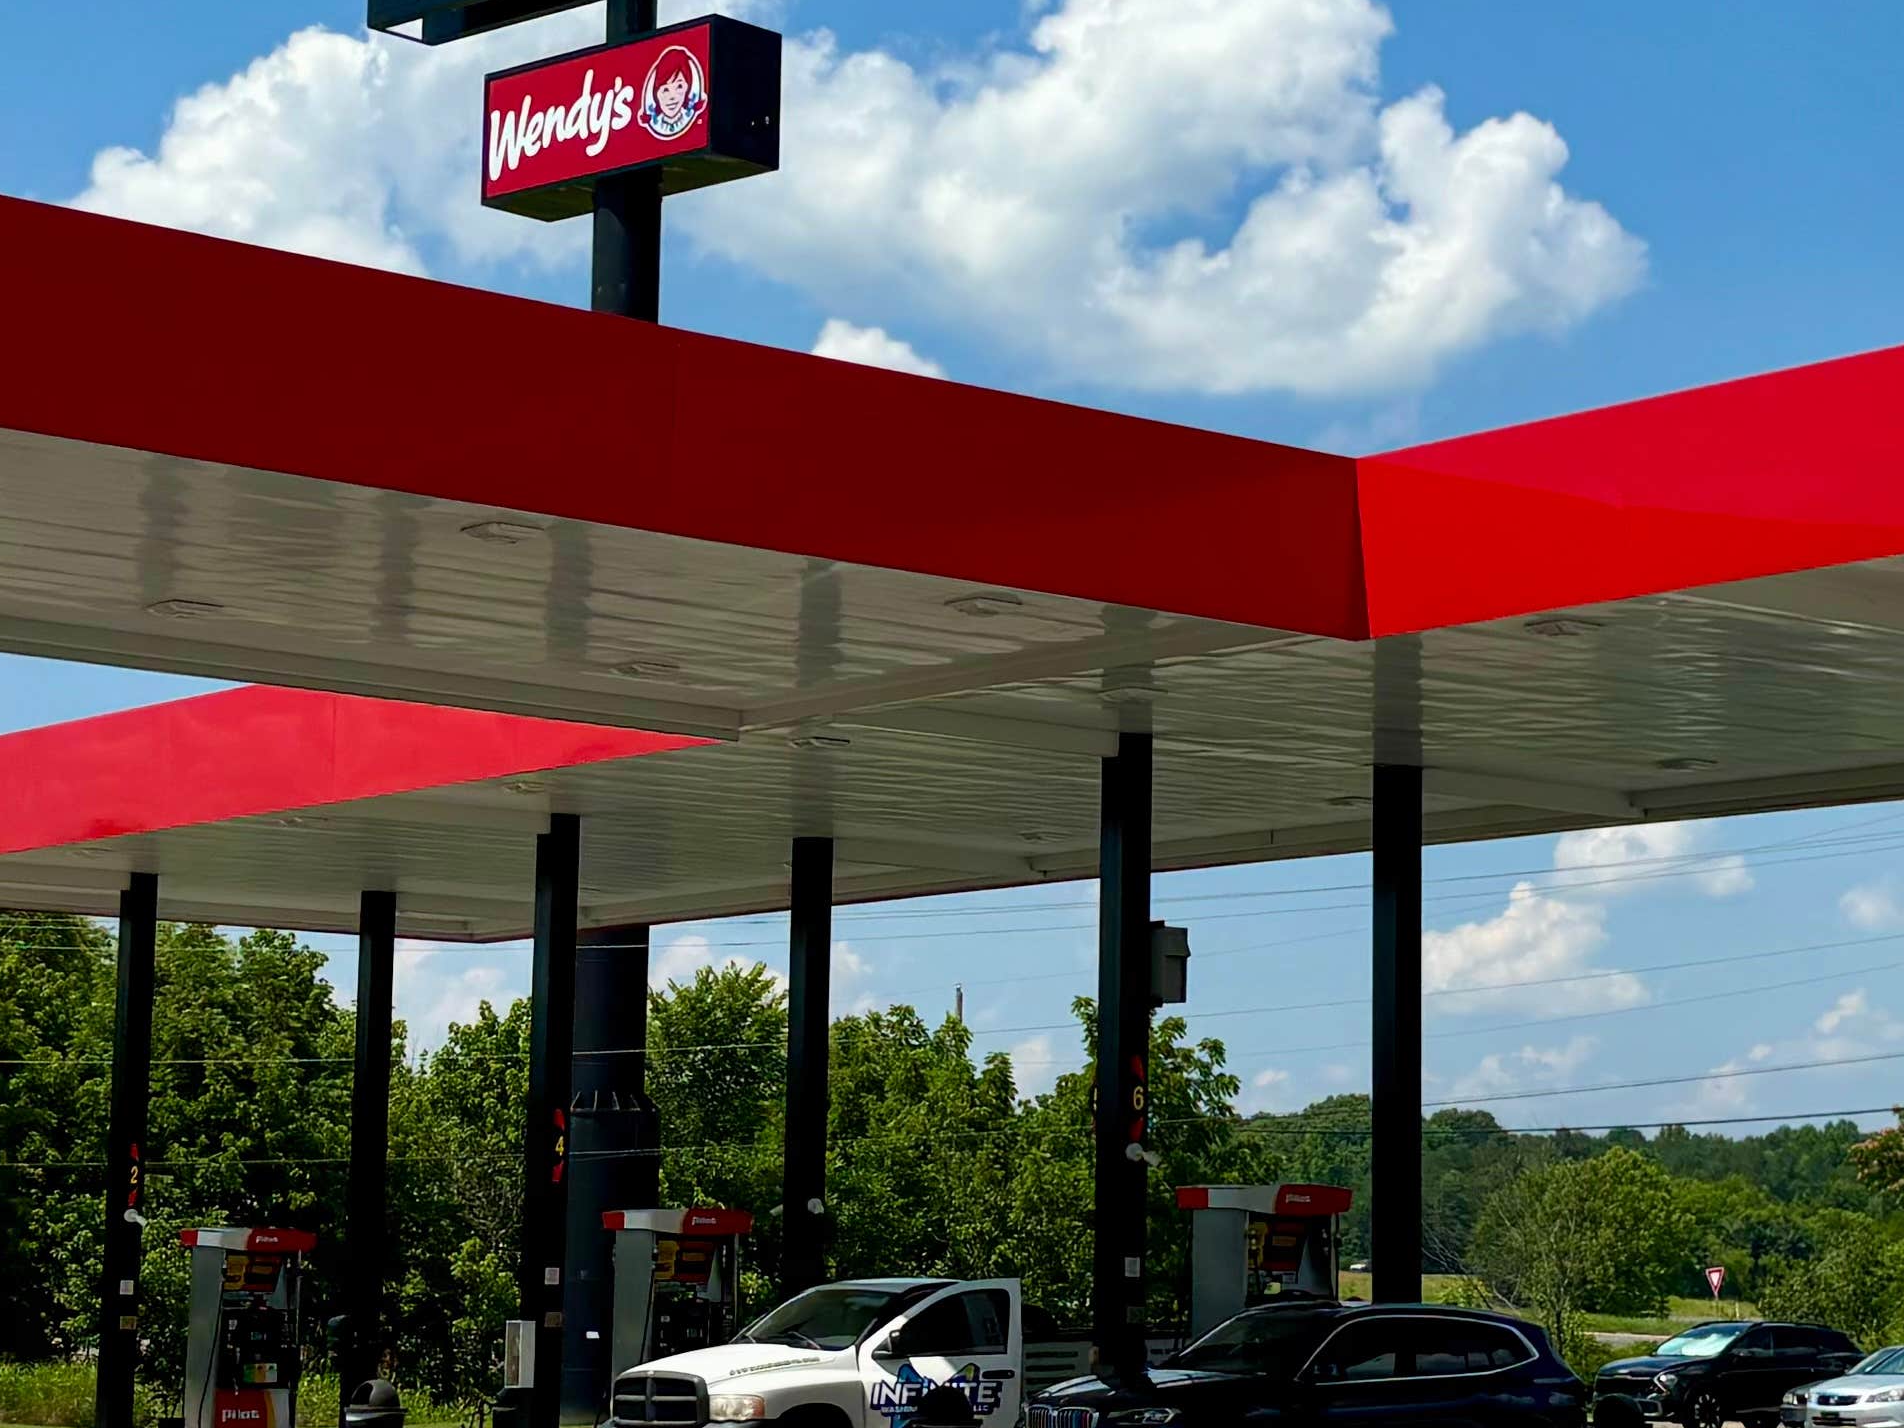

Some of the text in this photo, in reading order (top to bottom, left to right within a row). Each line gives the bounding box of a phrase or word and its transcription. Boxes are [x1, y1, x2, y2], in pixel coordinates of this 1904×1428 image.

[488, 68, 634, 182] Wendy's
[1133, 1085, 1145, 1110] 6
[555, 1135, 565, 1157] 4
[130, 1165, 139, 1184] 2
